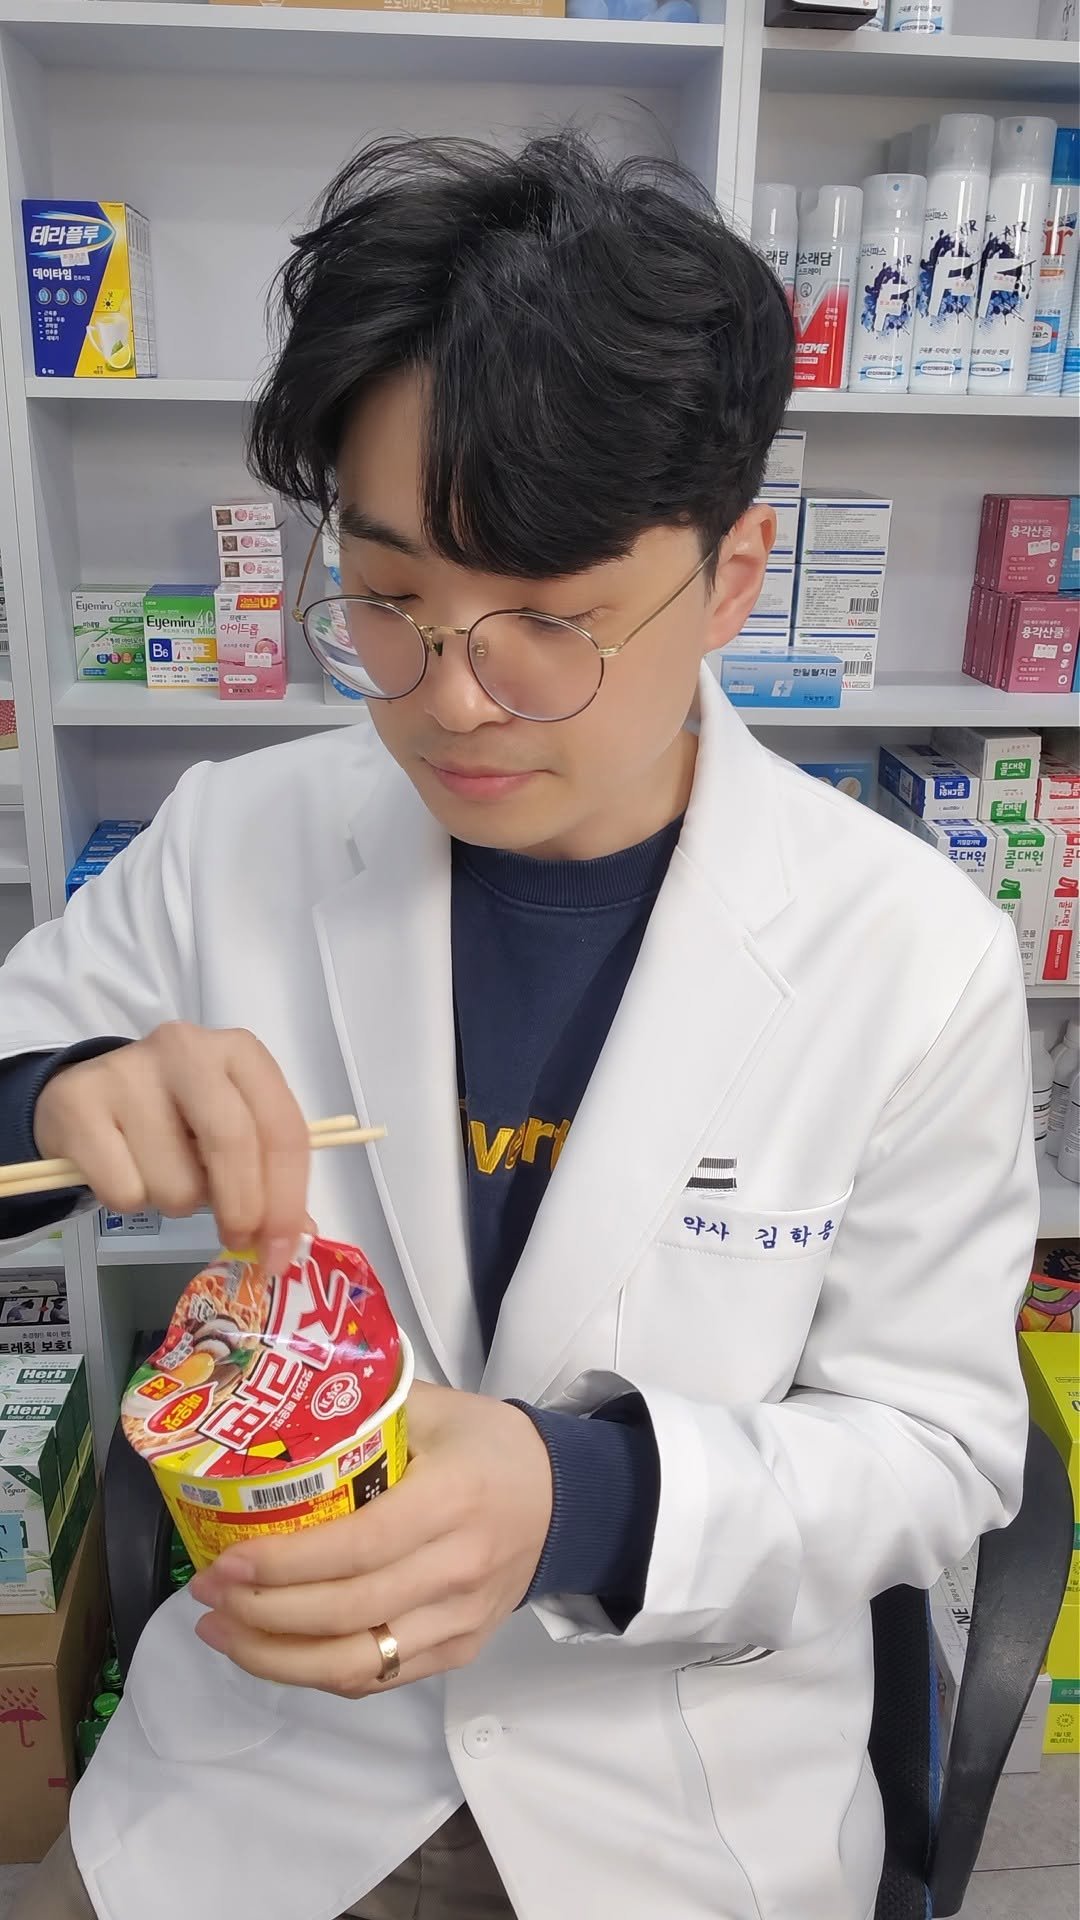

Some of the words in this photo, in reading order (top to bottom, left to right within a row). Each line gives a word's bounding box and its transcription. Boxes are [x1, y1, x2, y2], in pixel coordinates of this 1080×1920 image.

[30, 225, 99, 245] 테라플루
[33, 268, 72, 280] 데이타임
[76, 601, 113, 612] Eyemiru
[260, 598, 277, 608] UP
[146, 615, 195, 630] Eyemiru
[220, 623, 259, 636] 아이드롭
[152, 643, 169, 658] B6
[1004, 850, 1043, 869] 콜대원
[683, 1216, 730, 1241] 약사
[755, 1219, 834, 1249] 김학용
[22, 1369, 66, 1379] Herb
[319, 1381, 345, 1409] 오뚜기
[6, 1405, 52, 1415] Herb
[161, 1393, 203, 1431] 매운맛
